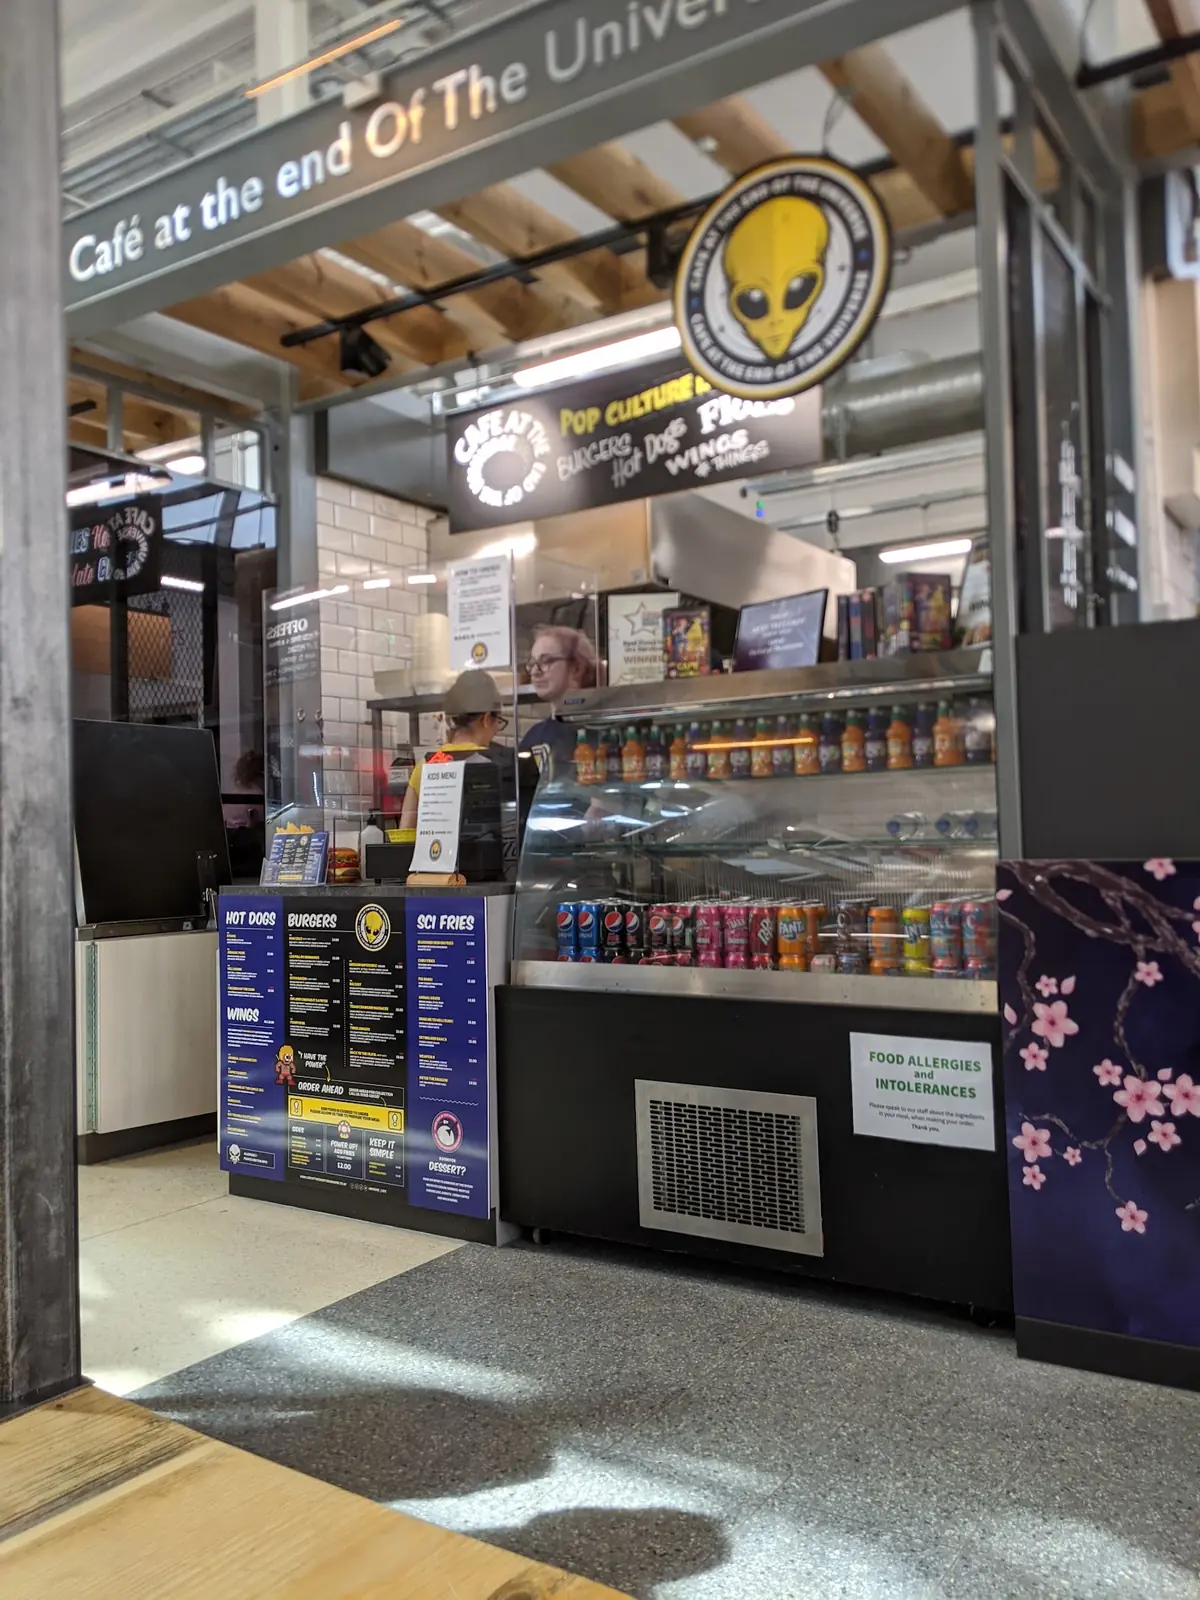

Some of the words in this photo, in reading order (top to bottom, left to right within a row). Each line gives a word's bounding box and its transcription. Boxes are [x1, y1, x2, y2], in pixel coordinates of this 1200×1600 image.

[69, 213, 144, 282] Café
[154, 203, 192, 250] at
[200, 178, 263, 231] the
[277, 120, 352, 198] end
[365, 86, 427, 159] Of
[433, 63, 528, 131] The
[560, 407, 601, 437] POP
[604, 371, 695, 428] CULTURE
[557, 432, 632, 481] BURGERS
[664, 428, 750, 476] WINGS
[427, 772, 440, 781] KIDS
[440, 771, 457, 780] MENU
[226, 910, 246, 925] HOT
[248, 911, 276, 926] DOGS
[288, 912, 337, 928] BURGERS
[417, 914, 437, 930] SCI
[439, 914, 475, 931] FRIES
[227, 1006, 260, 1022] WINGS
[869, 1051, 905, 1065] FOOD
[908, 1055, 981, 1072] ALLERGIES
[914, 1070, 934, 1080] and
[298, 1081, 321, 1092] ORDER
[321, 1084, 344, 1095] AHEAD
[875, 1078, 977, 1099] INTOLERANCES
[926, 1117, 945, 1125] making
[330, 1140, 348, 1149] POWER
[369, 1137, 387, 1148] KEEP
[388, 1140, 396, 1150] IT
[343, 1149, 356, 1157] FRIES
[369, 1147, 395, 1159] SIMPLE
[337, 1162, 352, 1170] £2.00
[428, 1161, 467, 1176] DESSERT?
